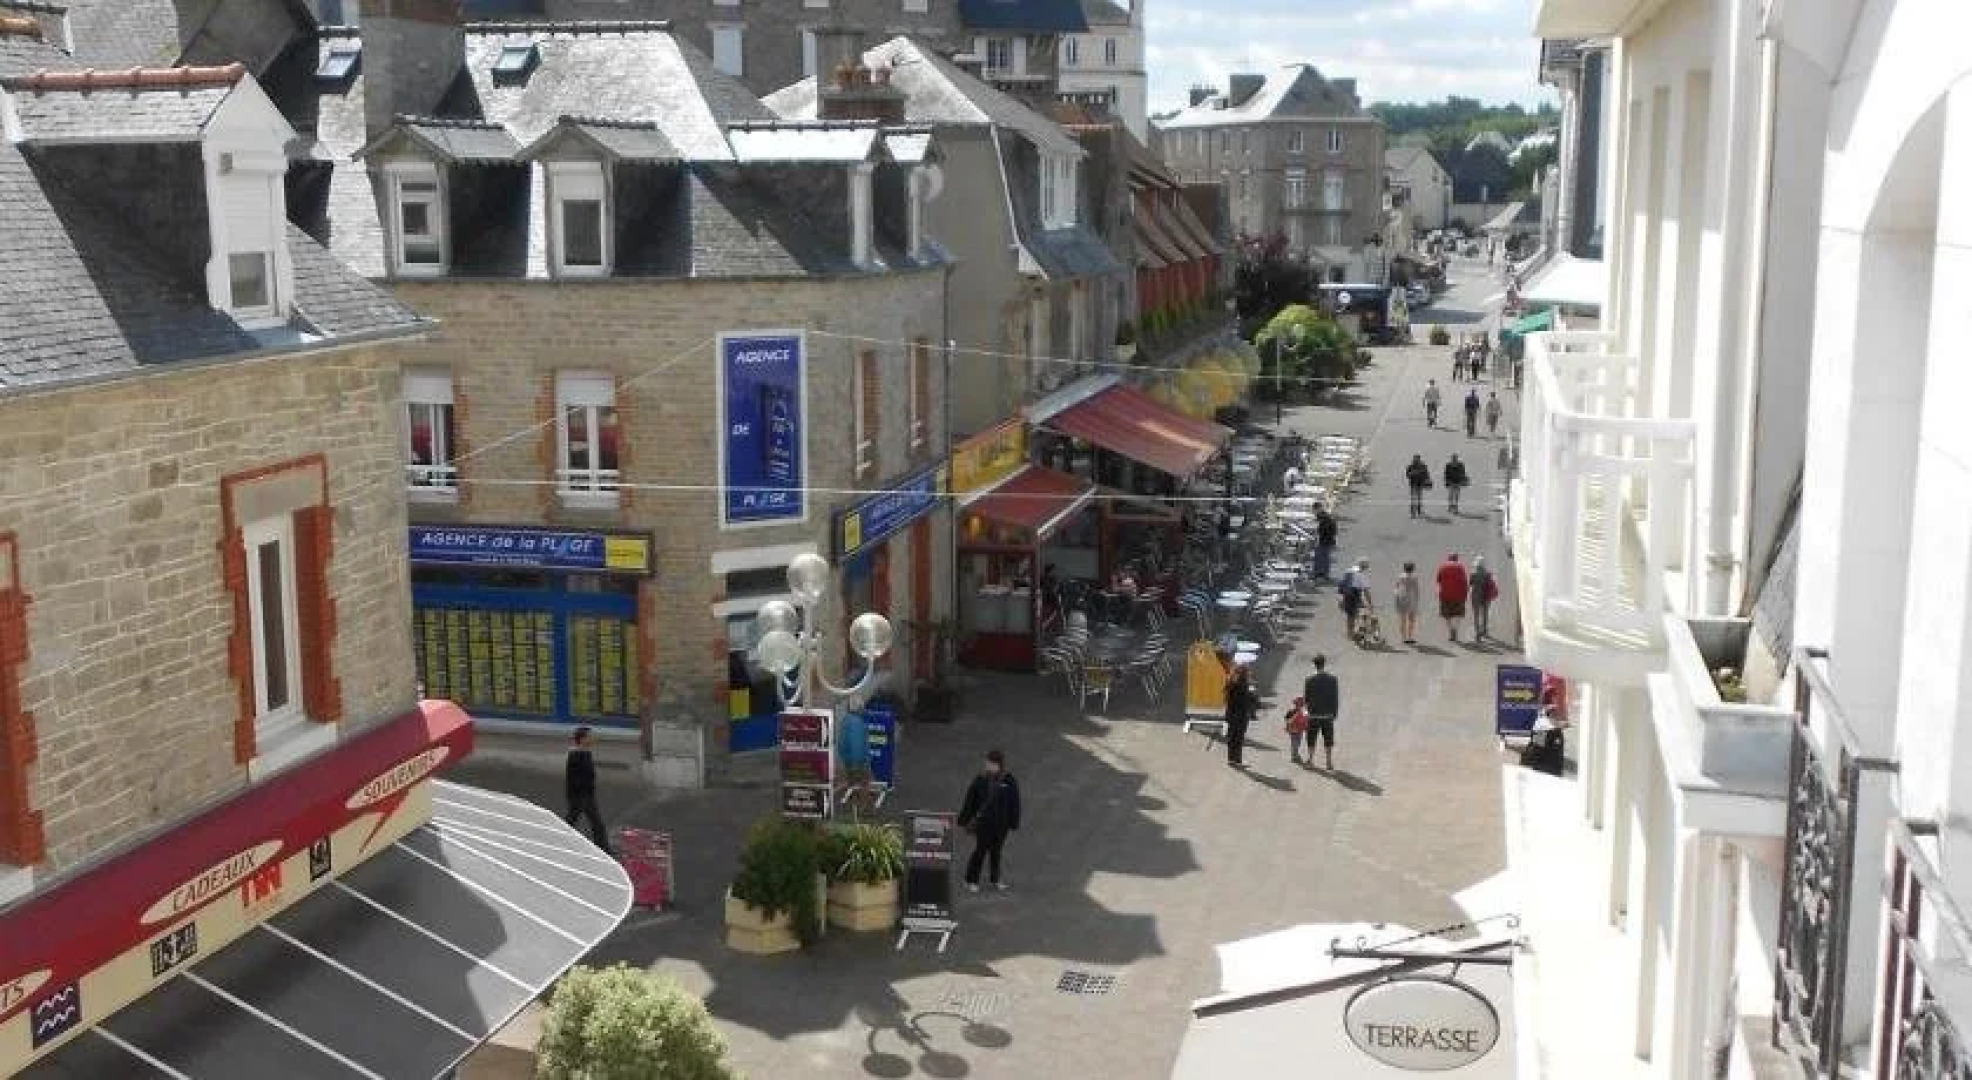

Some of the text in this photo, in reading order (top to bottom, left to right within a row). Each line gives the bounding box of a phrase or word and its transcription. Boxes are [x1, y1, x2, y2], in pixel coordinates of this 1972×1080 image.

[734, 348, 790, 363] AGENCE
[732, 423, 750, 436] DE
[421, 531, 487, 546] AGENCE
[518, 535, 535, 550] la
[173, 851, 256, 911] CADEAUX
[1363, 1023, 1480, 1053] TERRASSE
